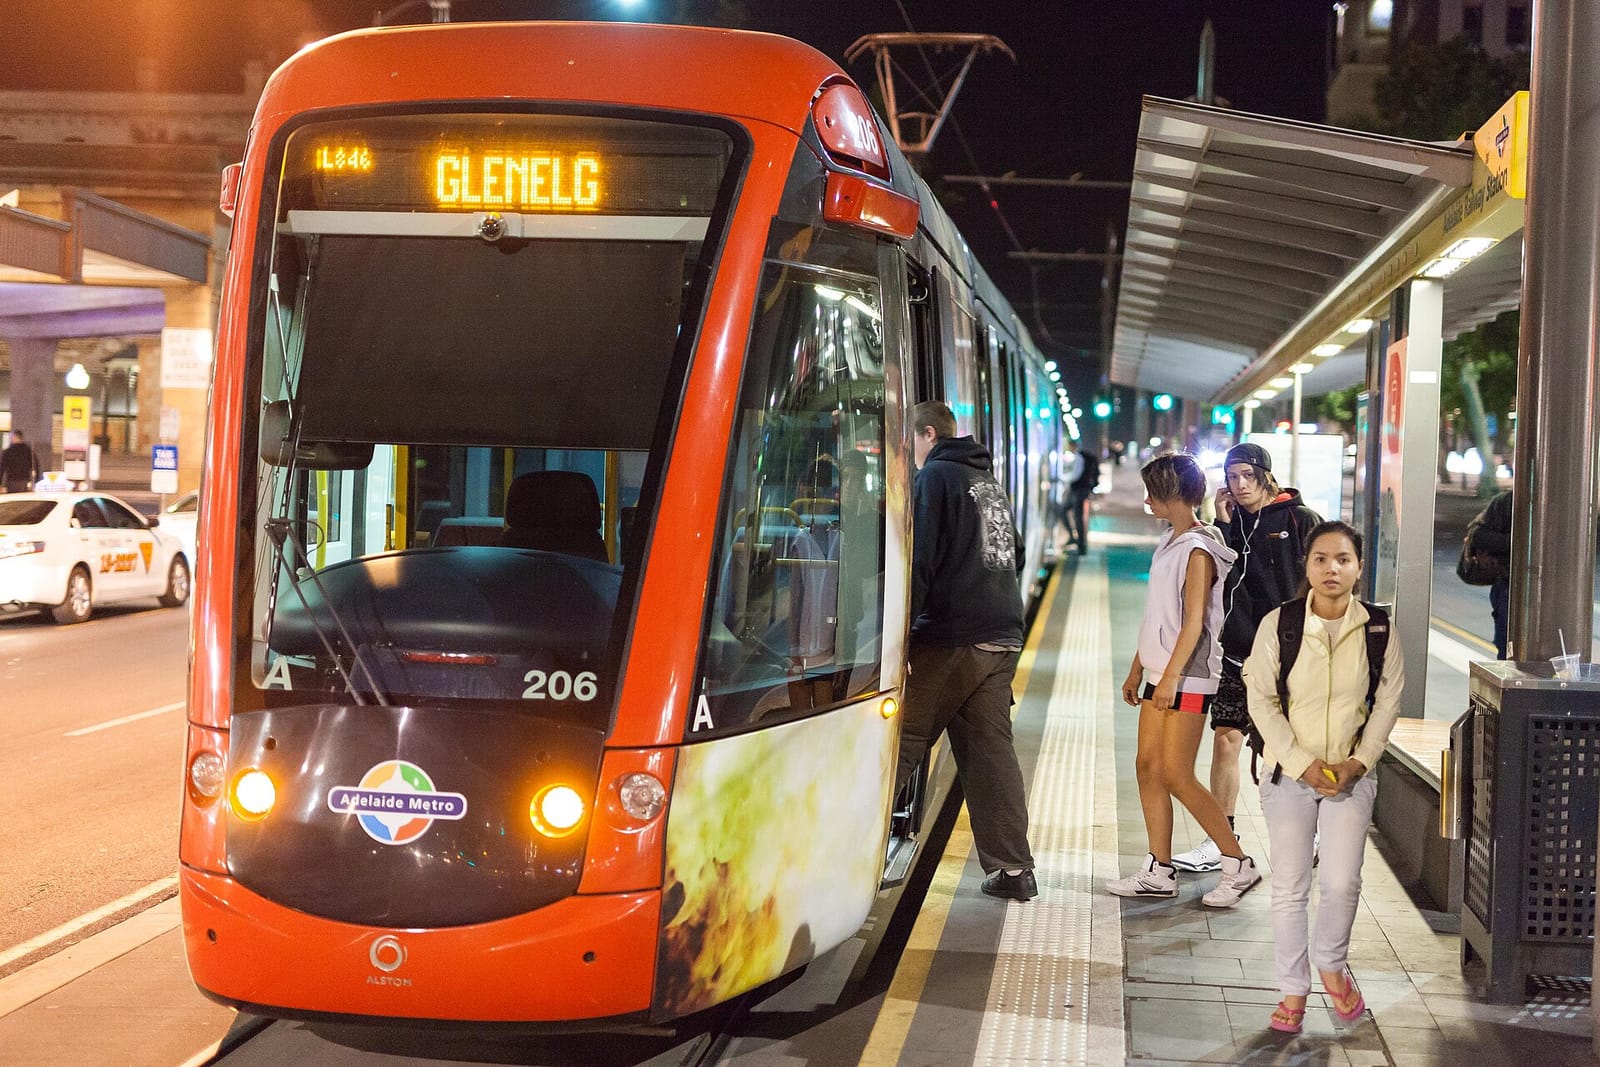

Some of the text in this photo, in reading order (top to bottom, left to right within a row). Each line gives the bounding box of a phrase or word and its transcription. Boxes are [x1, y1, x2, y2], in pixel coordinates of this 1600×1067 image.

[436, 155, 598, 205] GLENELG
[1486, 165, 1508, 202] Station
[261, 656, 293, 691] A
[521, 669, 598, 702] 206
[692, 694, 714, 732] A
[340, 793, 455, 812] Adelaide Metro
[366, 975, 412, 987] ALSTOM
